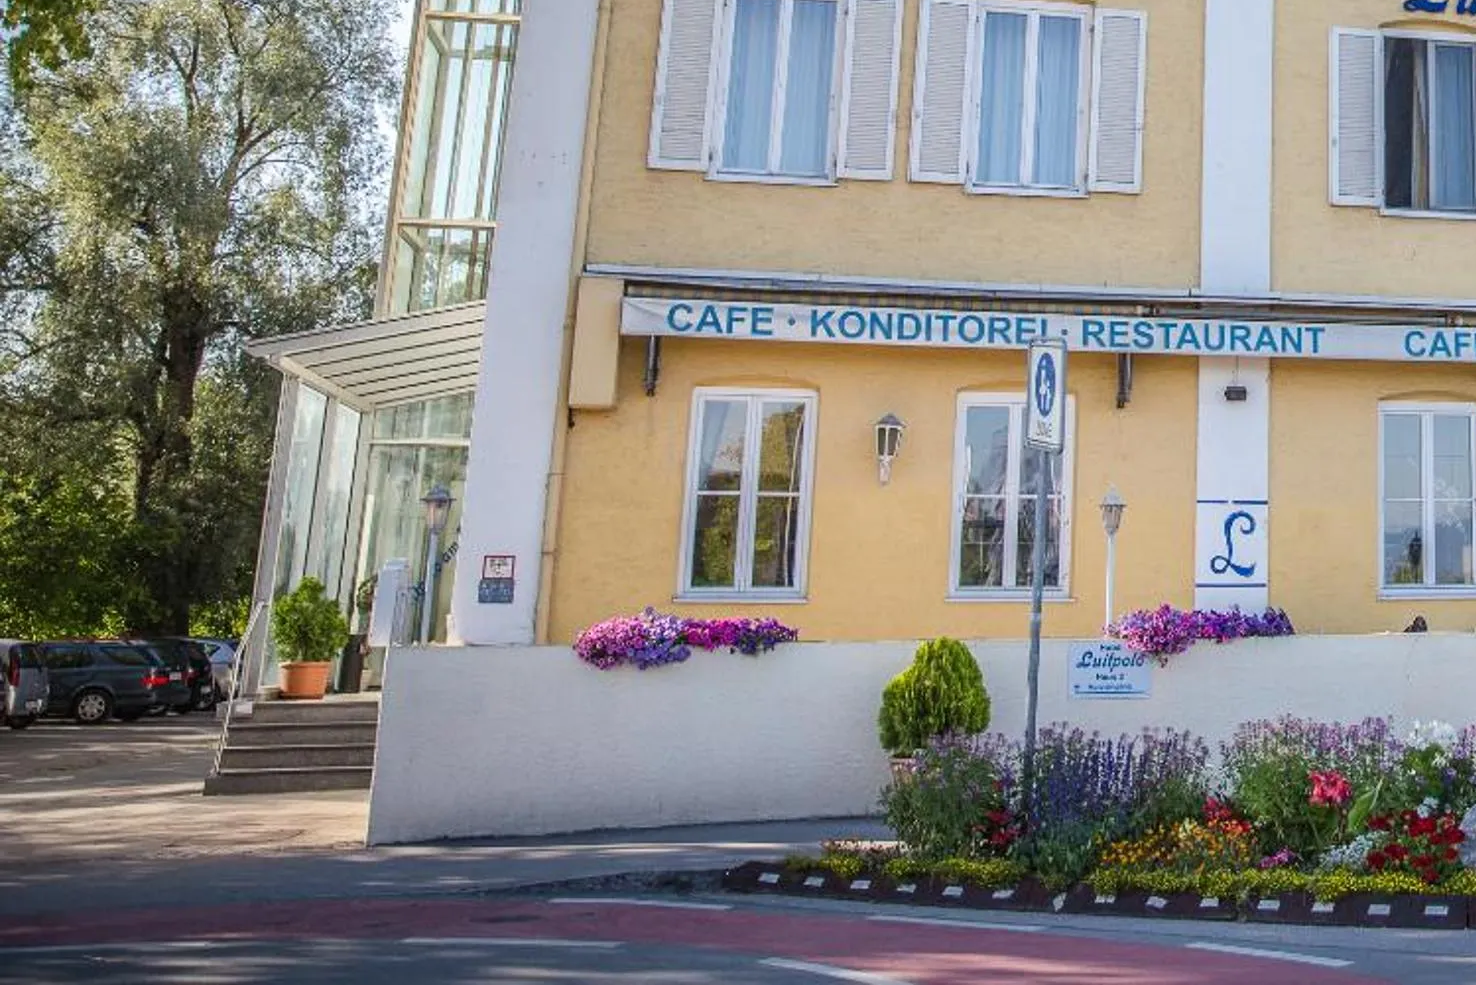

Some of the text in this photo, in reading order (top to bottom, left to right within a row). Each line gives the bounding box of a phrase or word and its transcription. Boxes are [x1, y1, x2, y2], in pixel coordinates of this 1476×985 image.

[667, 303, 1325, 354] CAFE KONDITOREI RESTAURANT
